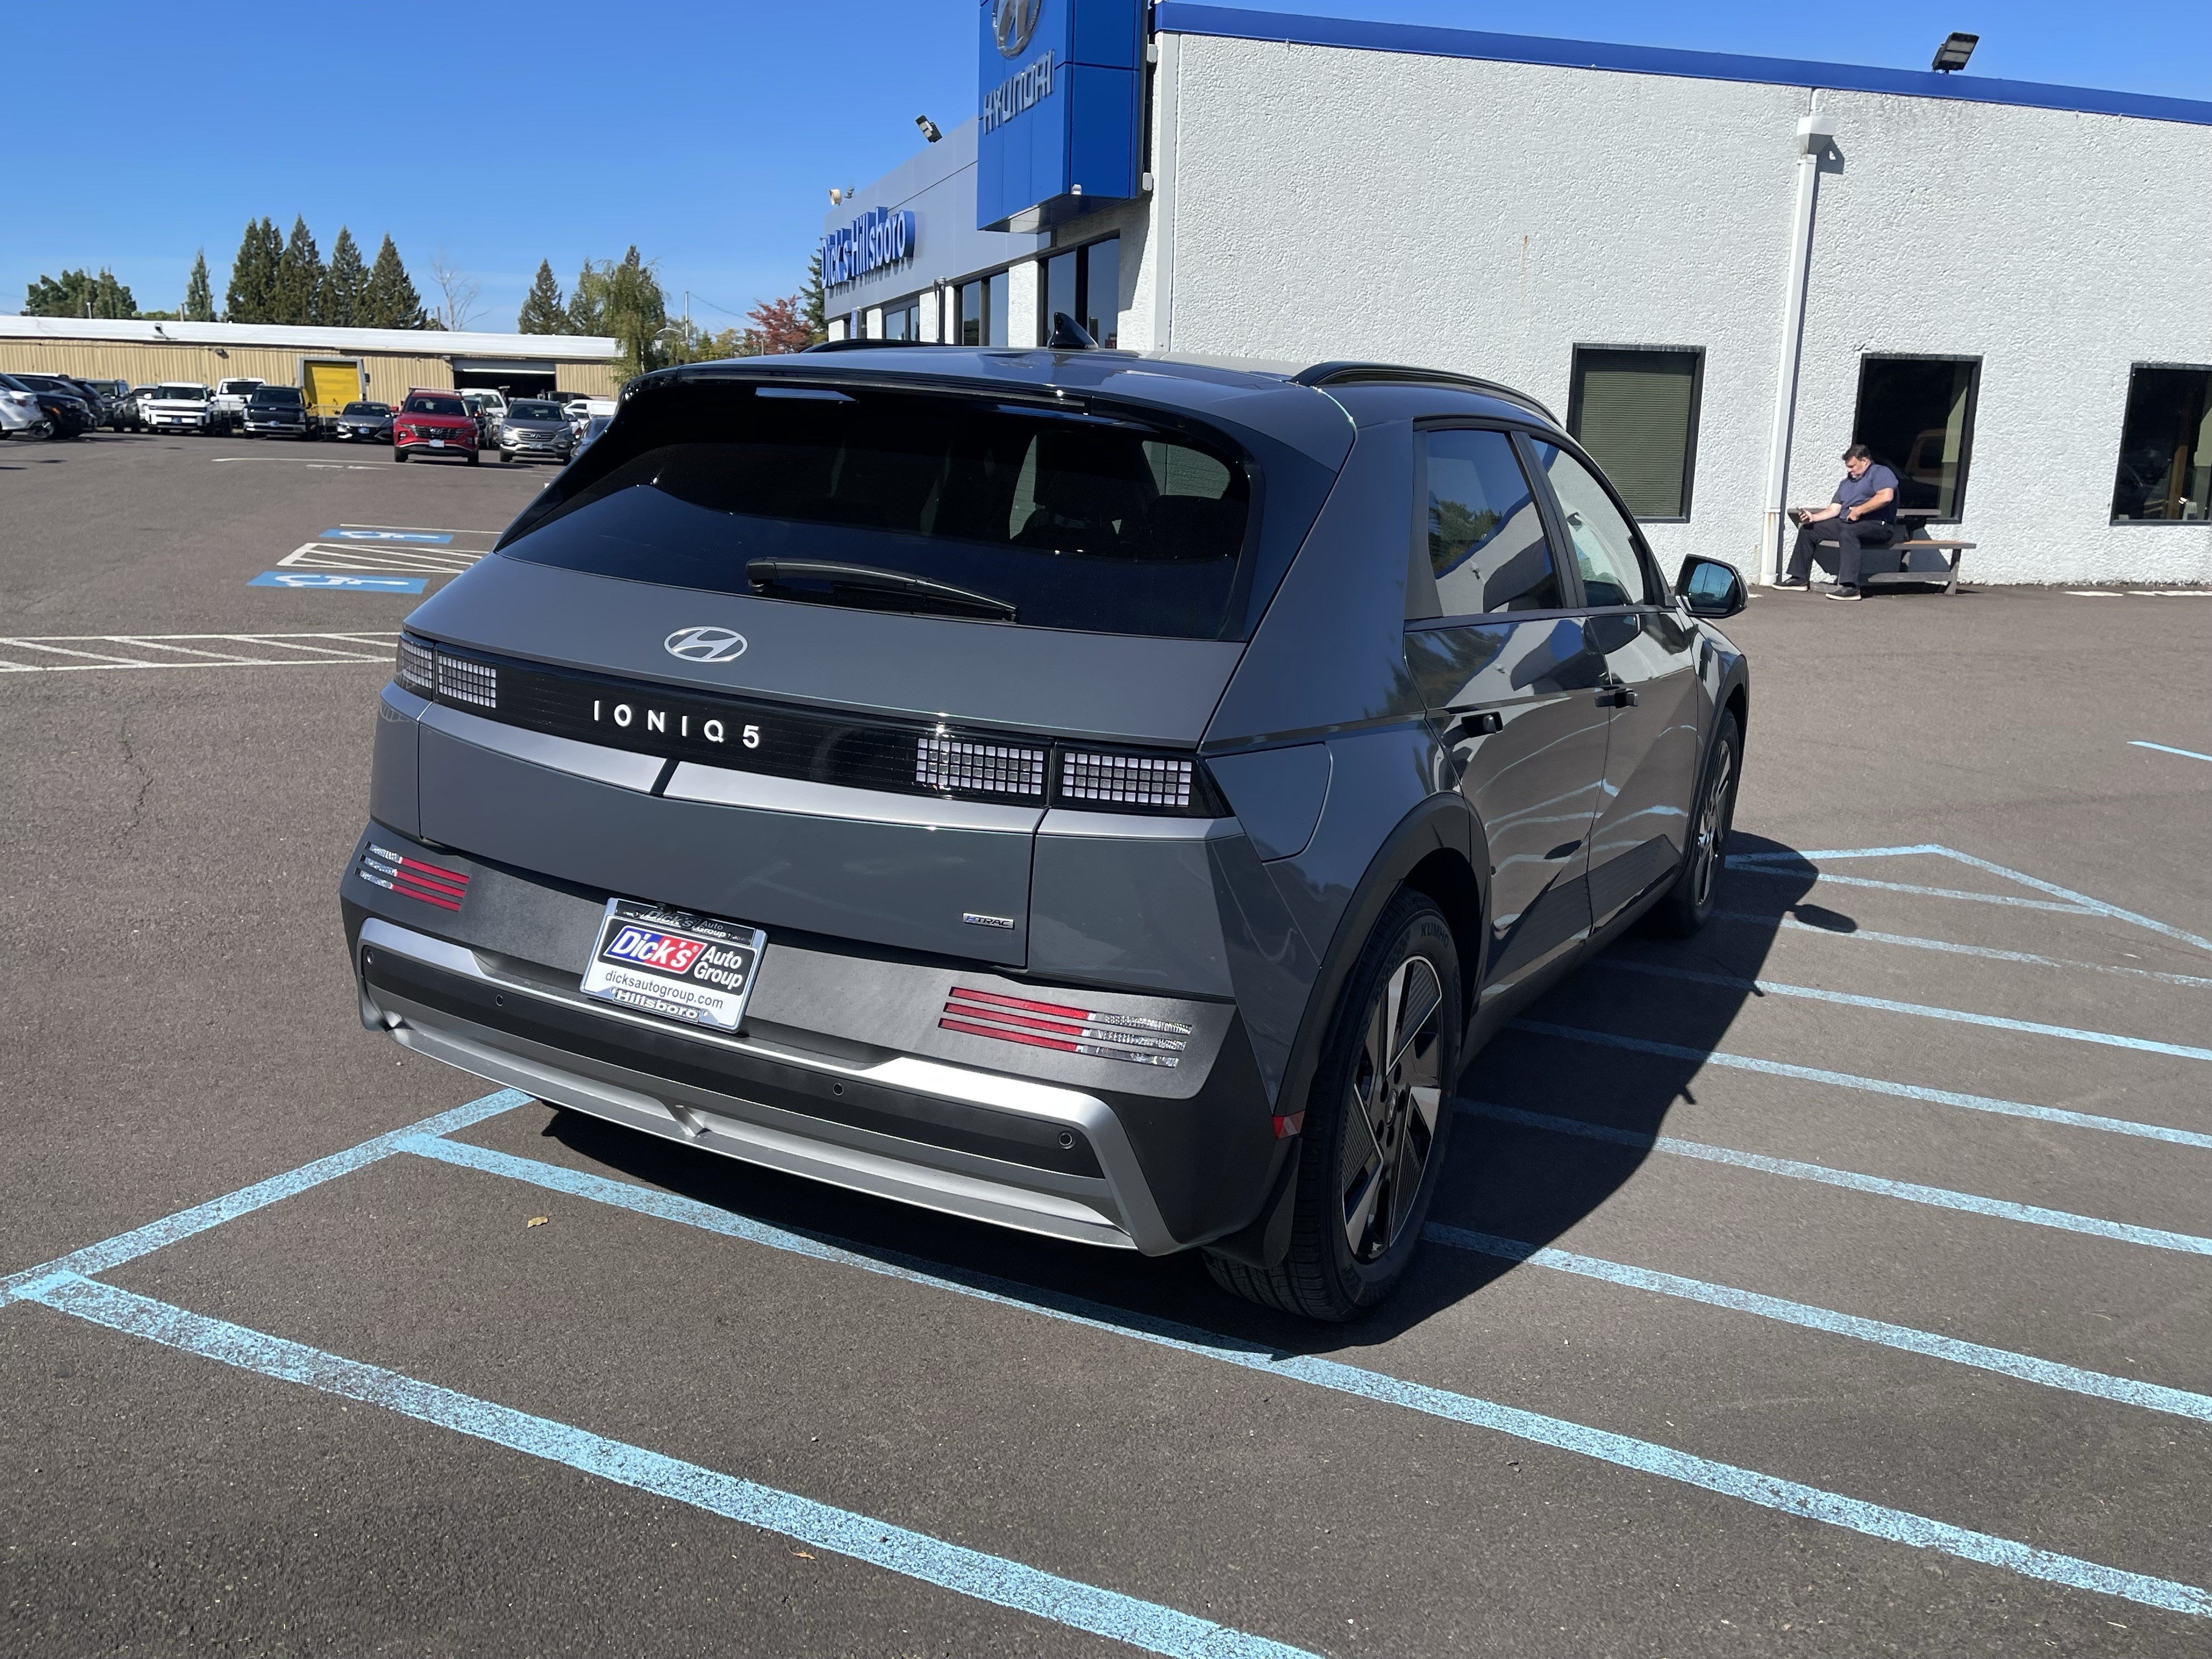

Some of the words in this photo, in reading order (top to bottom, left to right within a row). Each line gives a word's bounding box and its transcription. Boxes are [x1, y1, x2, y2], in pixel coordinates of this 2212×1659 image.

[984, 49, 1055, 135] HYUNDAI
[821, 227, 849, 289] Dick's
[851, 206, 907, 277] Hillsboro
[594, 700, 724, 743] IONIQ
[742, 724, 759, 748] 5
[701, 921, 724, 930] Auto
[1421, 922, 1449, 949] KUMHO
[612, 931, 692, 968] Dick's
[701, 946, 742, 969] Auto
[605, 970, 724, 1009] dicksautogroup.com
[694, 963, 743, 990] Group
[616, 990, 699, 1019] Hillsboro
